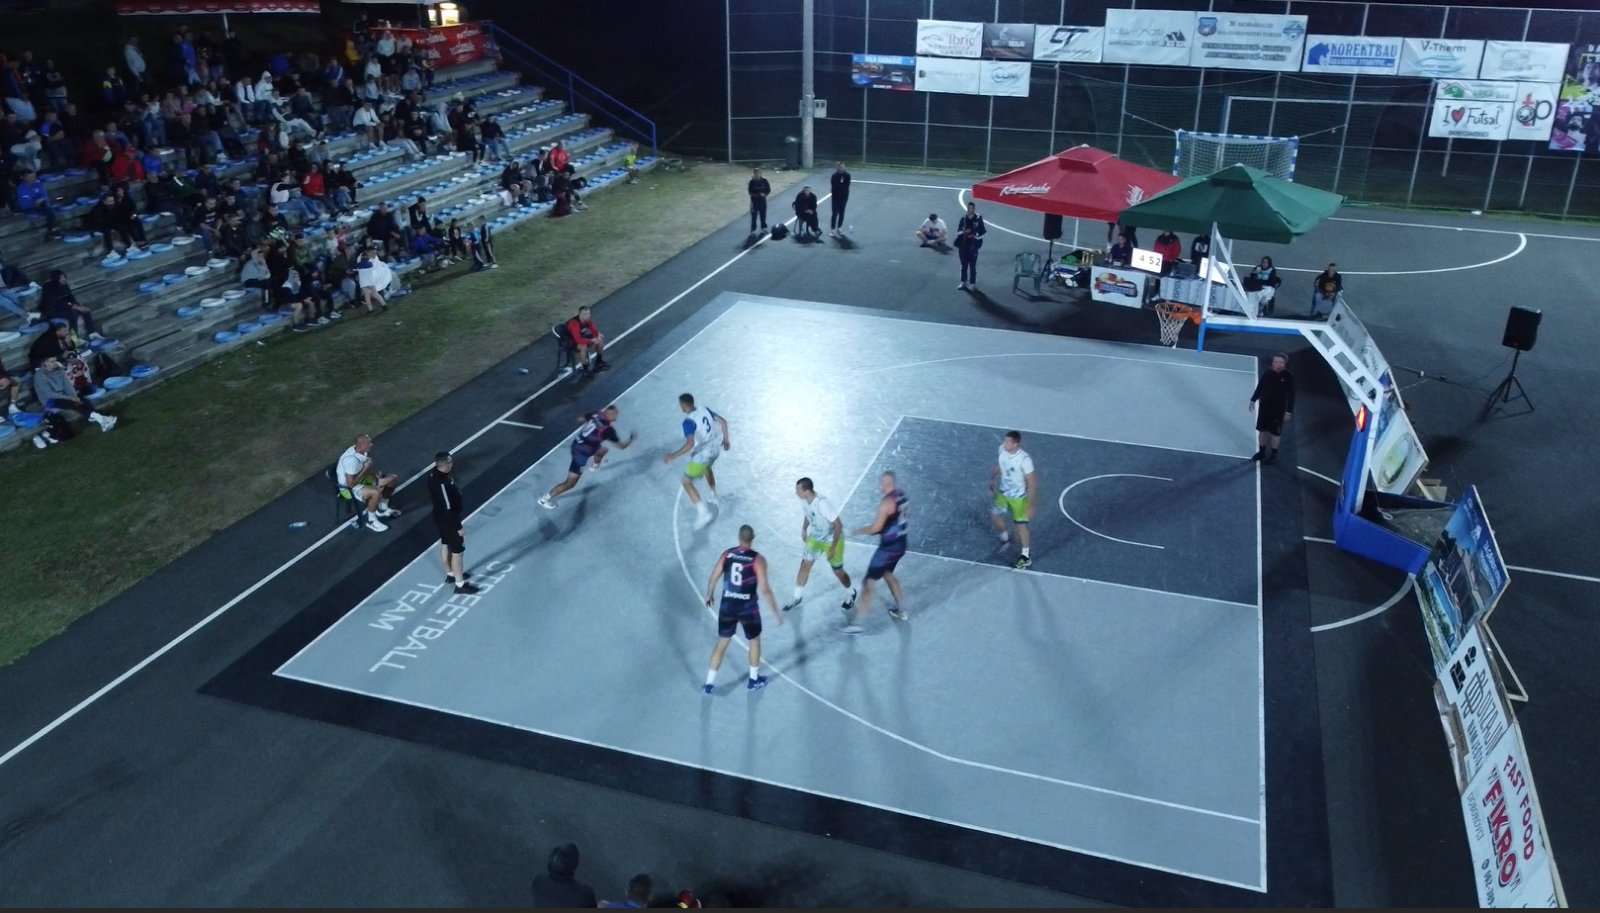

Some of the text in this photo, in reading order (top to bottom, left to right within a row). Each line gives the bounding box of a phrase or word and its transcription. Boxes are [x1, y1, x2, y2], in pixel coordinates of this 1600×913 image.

[1466, 107, 1501, 126] Futsal
[702, 416, 711, 433] 3
[730, 562, 744, 586] 6
[368, 583, 444, 631] TEAM
[1503, 755, 1535, 861] FAST FOOD
